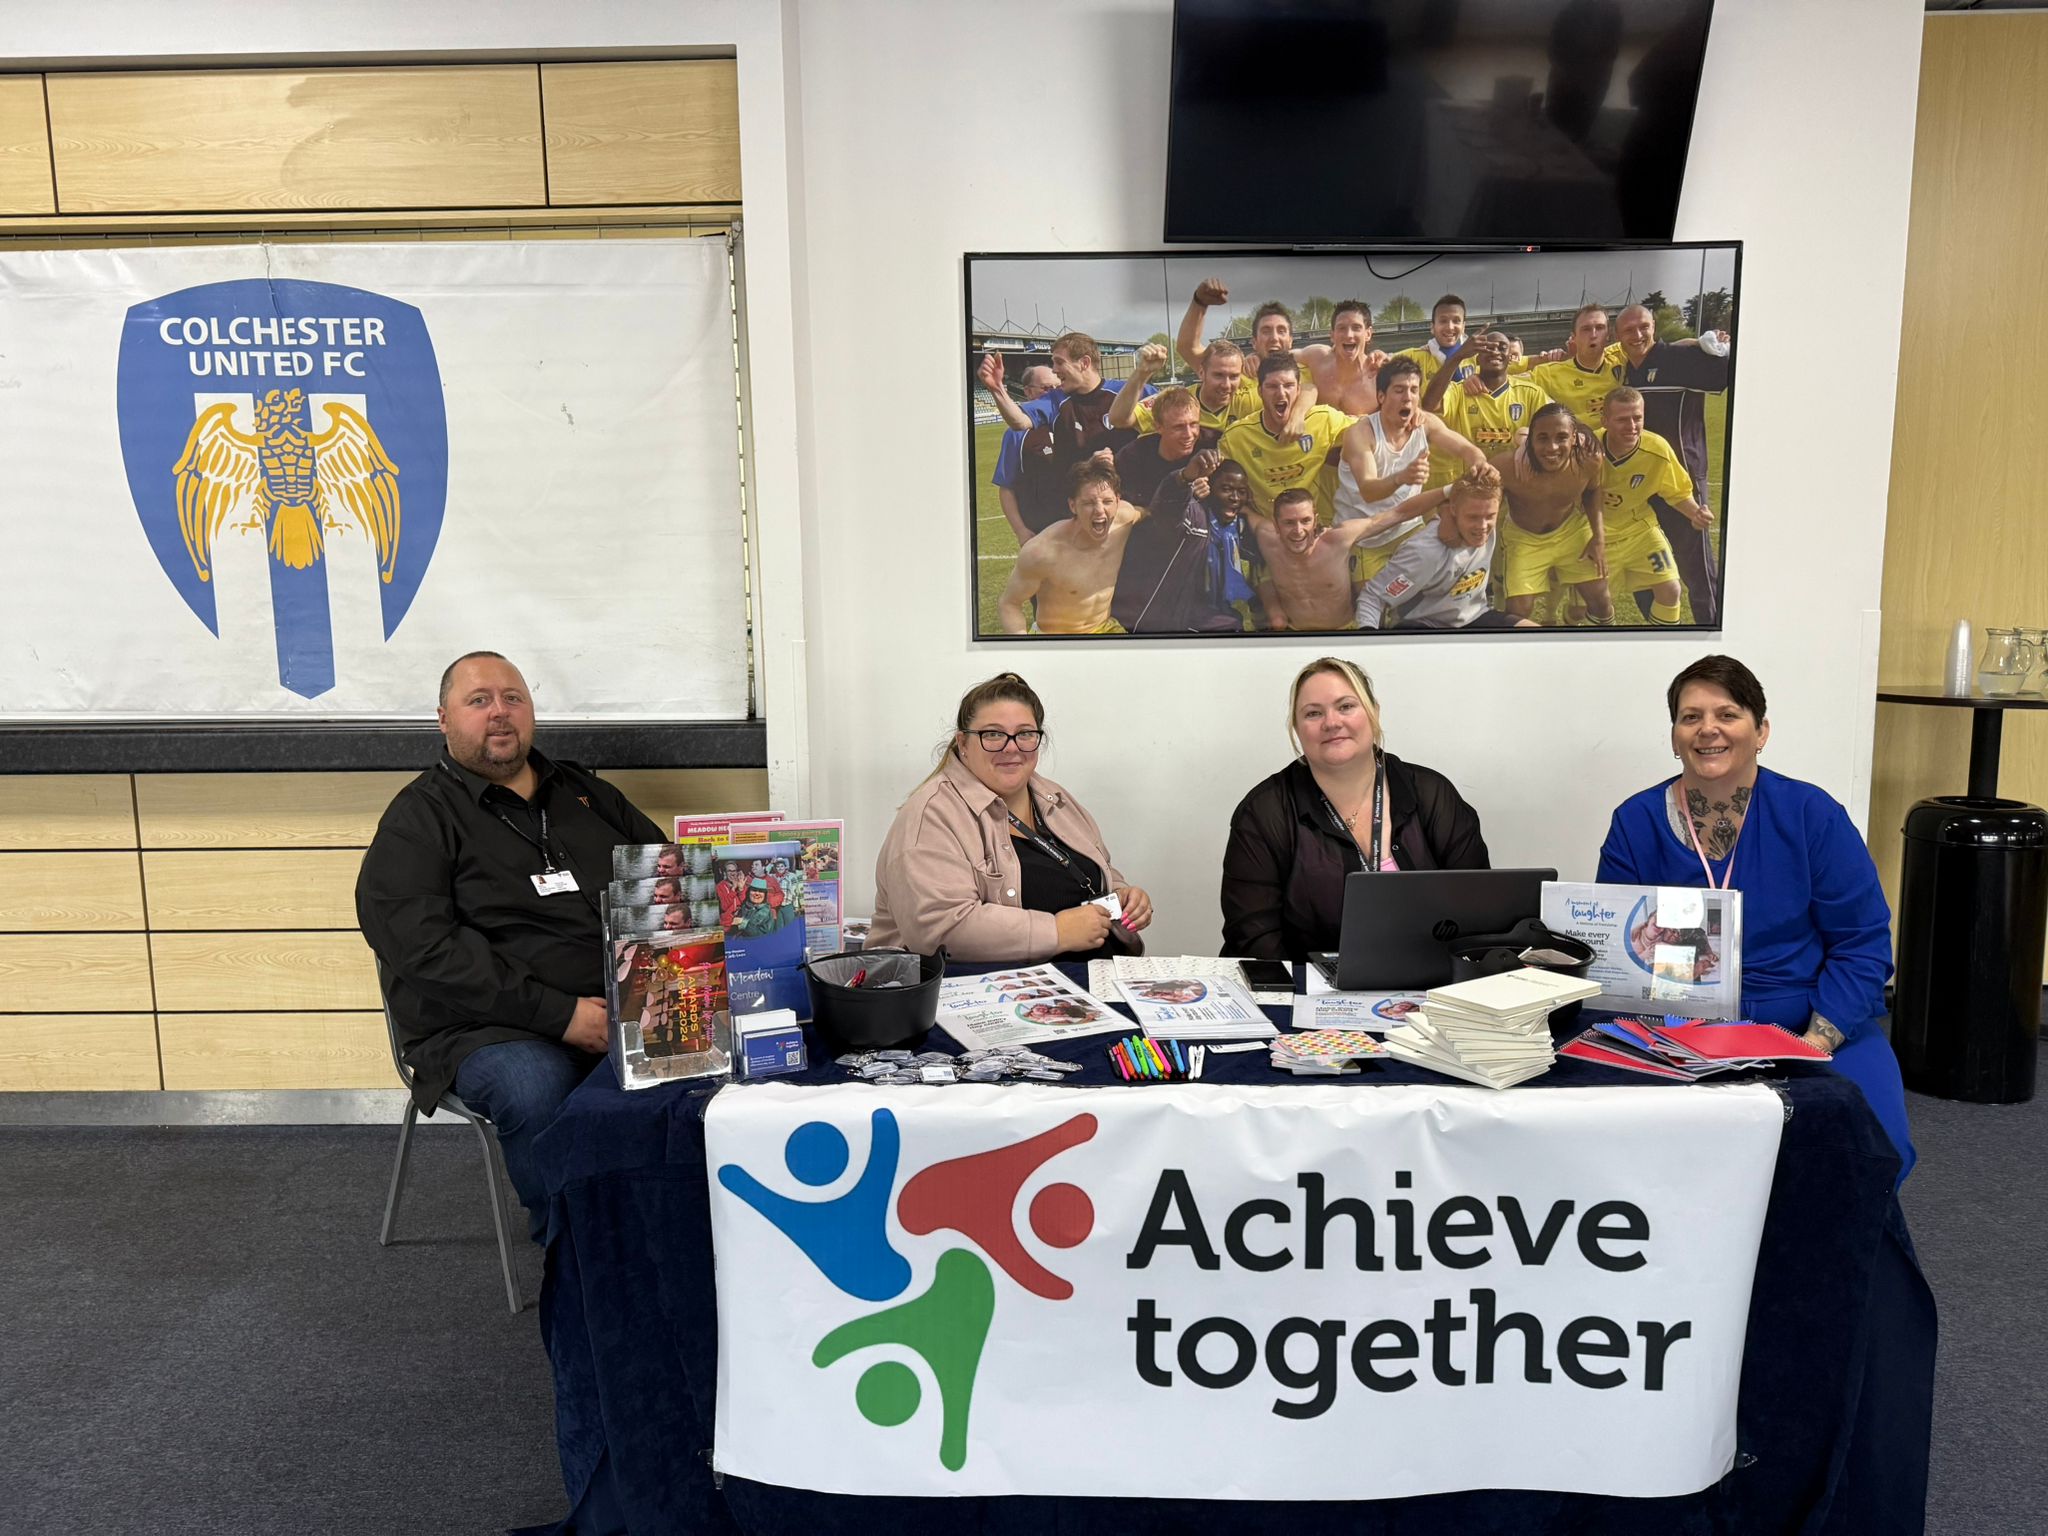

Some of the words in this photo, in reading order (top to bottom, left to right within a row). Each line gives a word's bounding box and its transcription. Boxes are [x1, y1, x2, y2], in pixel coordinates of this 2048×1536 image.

[159, 316, 387, 346] COLCHESTER
[189, 351, 314, 377] UNITED
[323, 351, 366, 377] FC
[1648, 550, 1672, 573] 31
[687, 826, 717, 834] MEADOW
[1571, 904, 1616, 922] laughter
[1565, 929, 1586, 938] Make
[1588, 931, 1610, 941] every
[677, 967, 687, 1008] NIGHT
[729, 967, 774, 987] Meadow
[688, 975, 699, 1032] AWARDS
[730, 990, 760, 1001] Centre
[679, 1010, 689, 1042] 2024
[1126, 1169, 1650, 1273] Achieve
[1127, 1288, 1692, 1420] together
